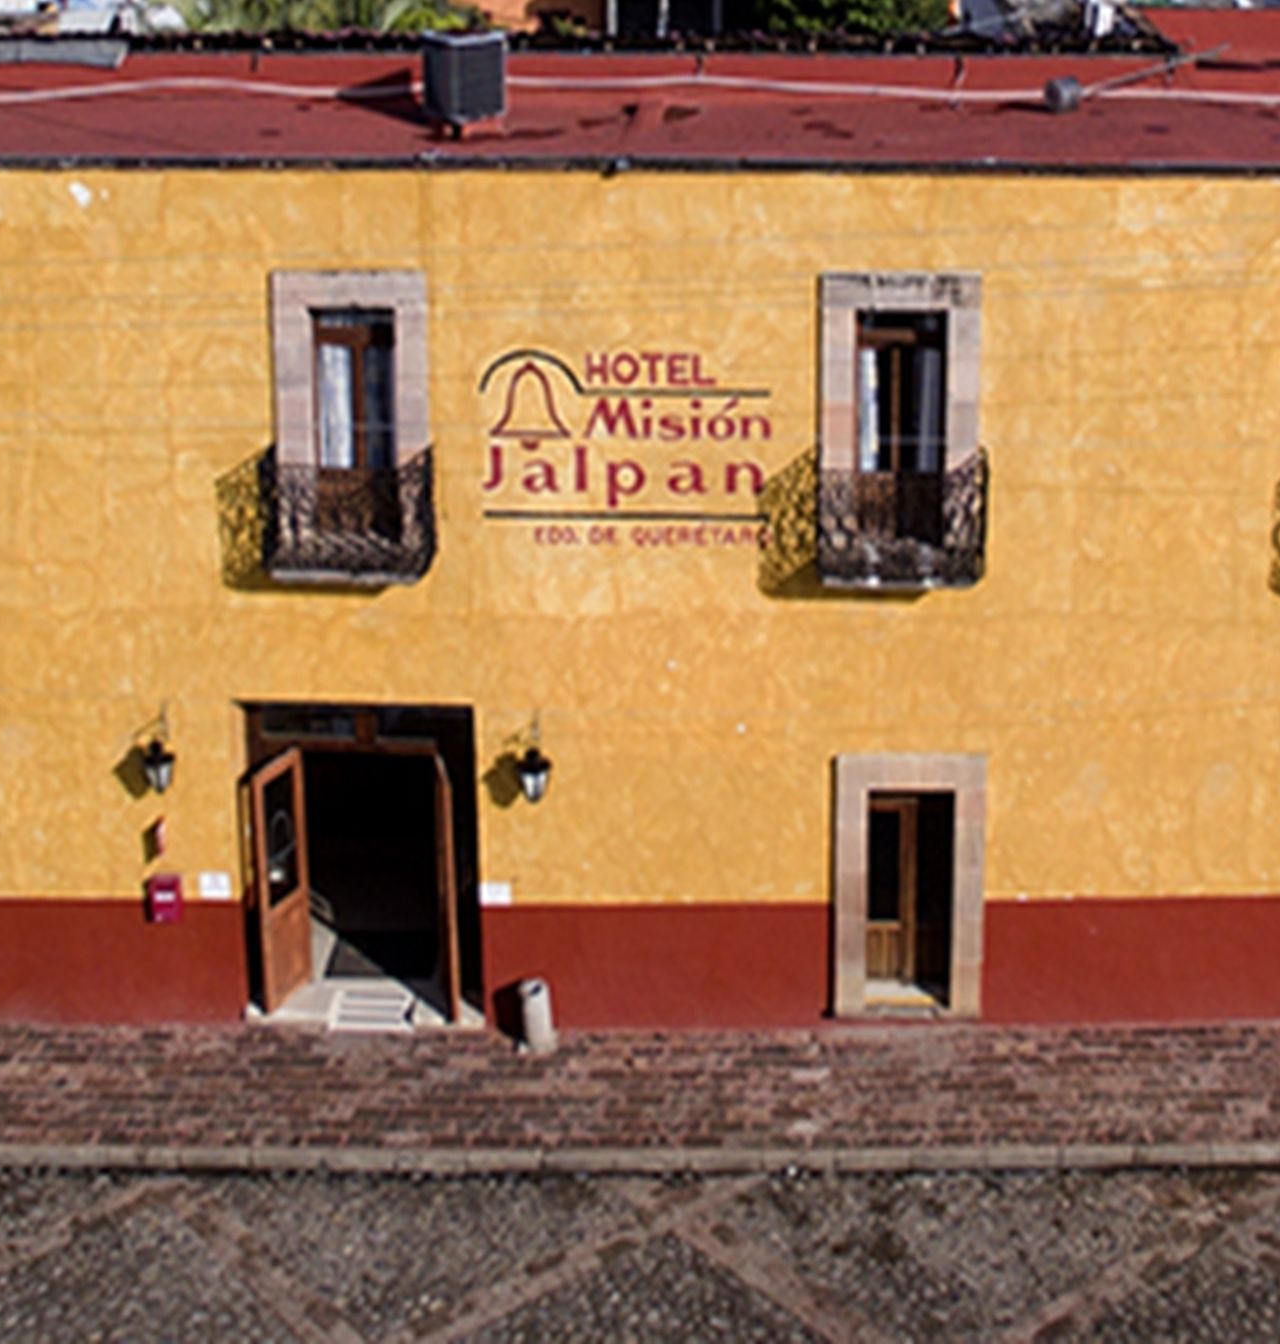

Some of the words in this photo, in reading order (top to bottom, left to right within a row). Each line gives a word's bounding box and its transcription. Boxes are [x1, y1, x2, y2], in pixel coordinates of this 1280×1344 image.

[584, 352, 716, 385] HOTEL
[583, 396, 772, 441] Misión
[482, 445, 765, 508] Jalpan
[588, 526, 616, 546] DE
